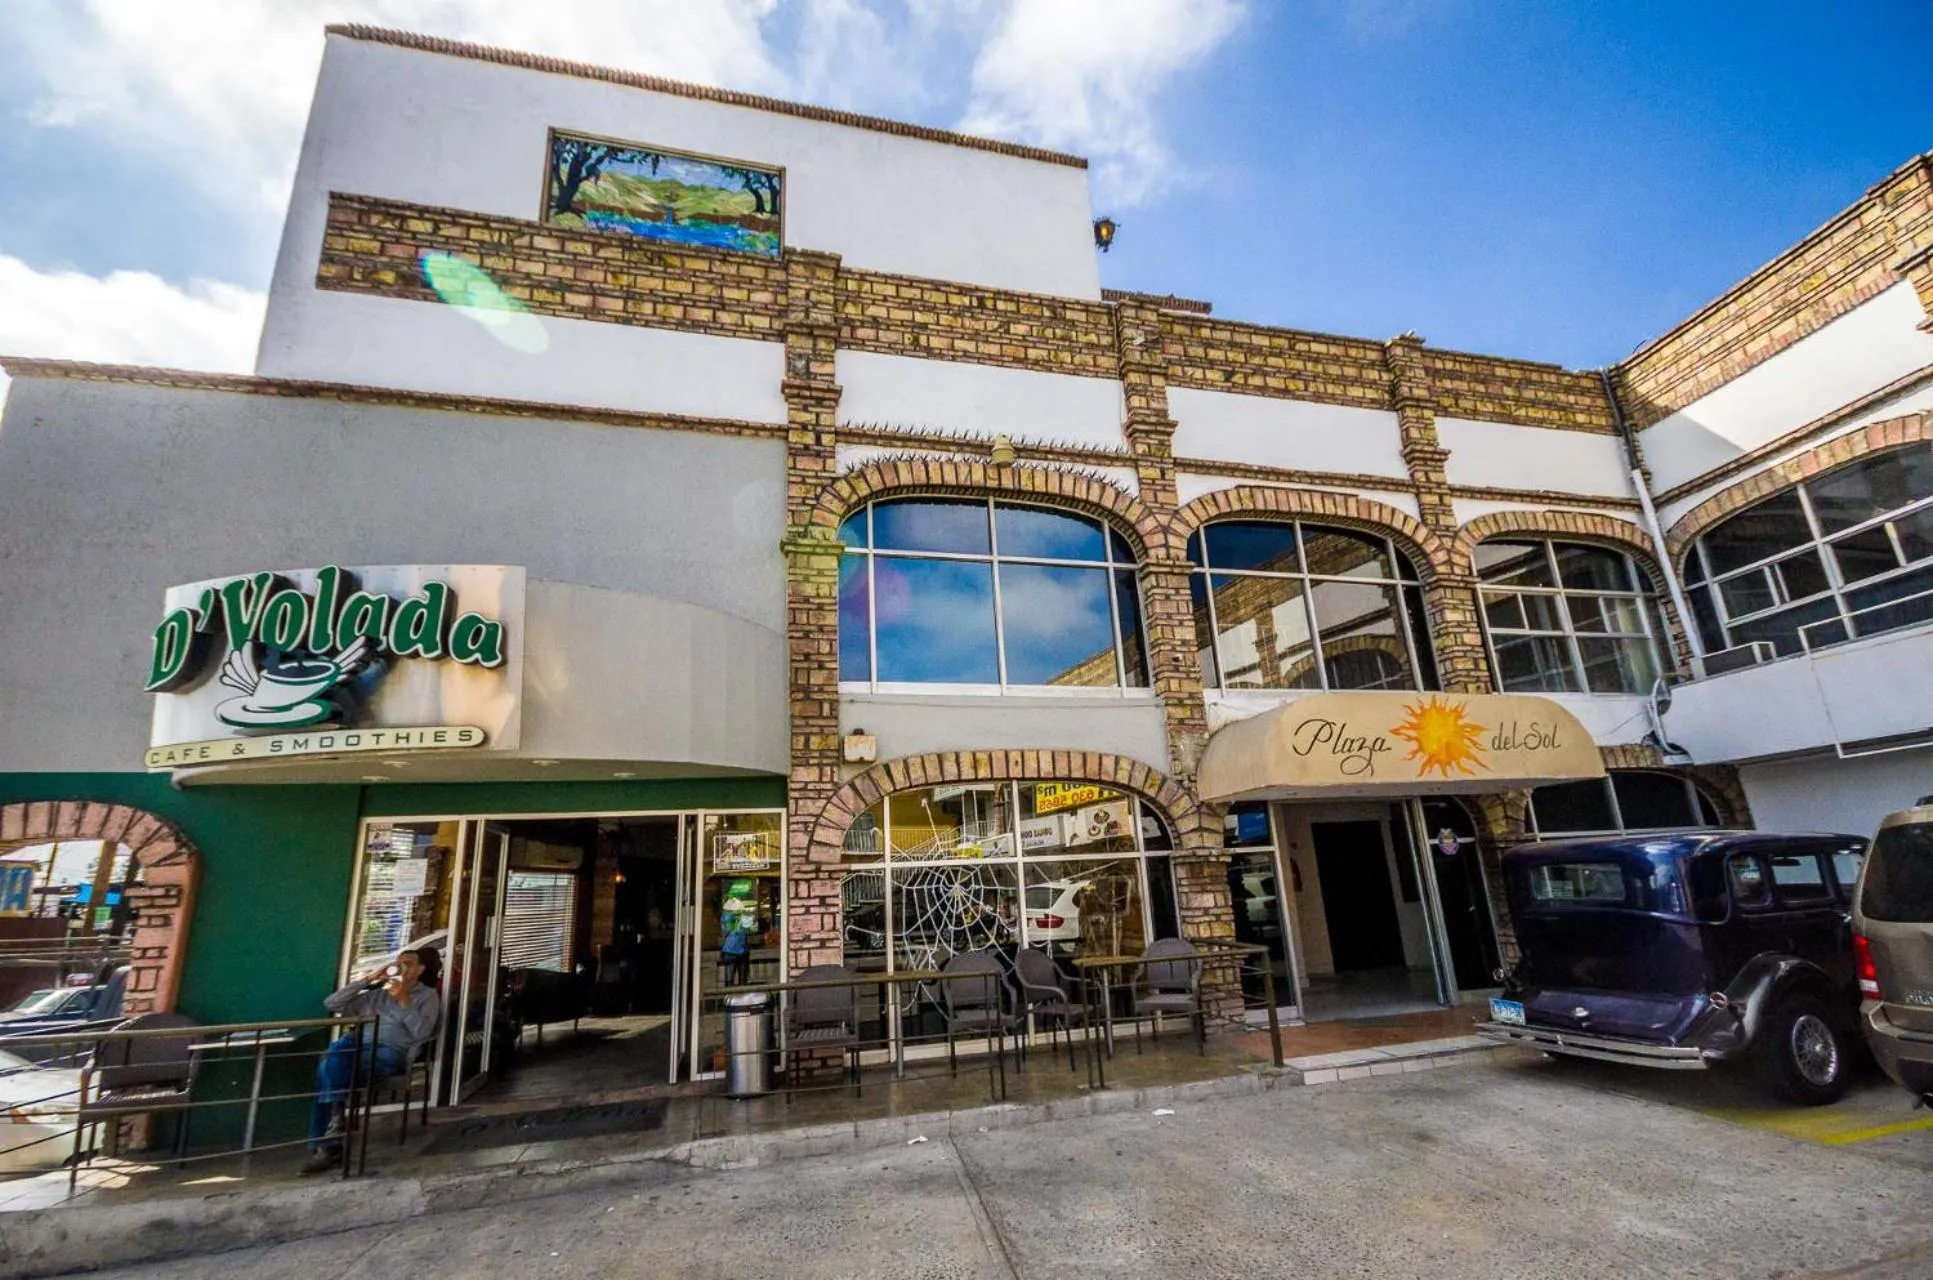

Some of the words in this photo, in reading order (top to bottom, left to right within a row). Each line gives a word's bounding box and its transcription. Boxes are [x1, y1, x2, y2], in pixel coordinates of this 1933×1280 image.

[144, 564, 505, 692] D'Volada
[149, 745, 211, 765] CAFE
[232, 742, 247, 756] &
[269, 729, 474, 753] SMOOTHIES
[1292, 718, 1392, 777] Plaza
[1492, 721, 1522, 751] del
[1523, 721, 1561, 750] Sol
